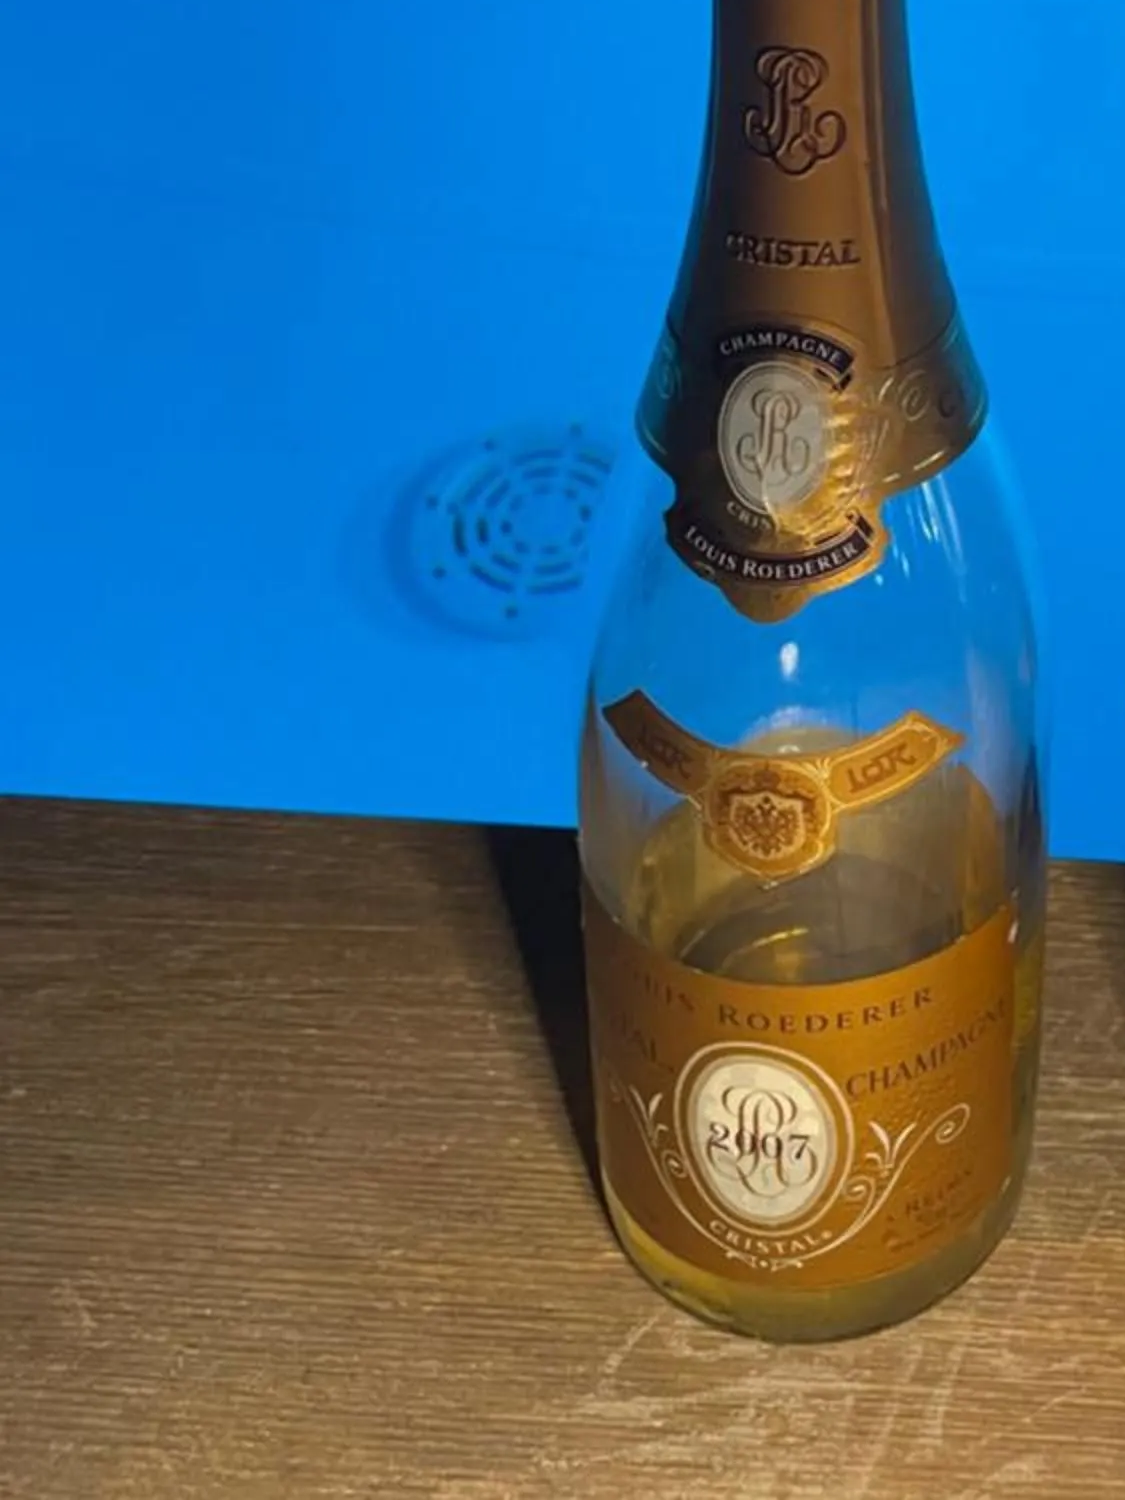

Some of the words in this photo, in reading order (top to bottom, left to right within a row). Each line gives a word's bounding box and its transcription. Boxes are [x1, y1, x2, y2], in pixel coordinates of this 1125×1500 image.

[724, 229, 862, 267] CRISTAL
[719, 331, 844, 364] CHAMPAGNE
[684, 525, 737, 570] LOUIS
[743, 545, 861, 580] ROEDERER
[718, 986, 933, 1035] ROEDERER
[708, 1121, 811, 1161] 2007
[709, 1219, 819, 1255] CRISTAL
